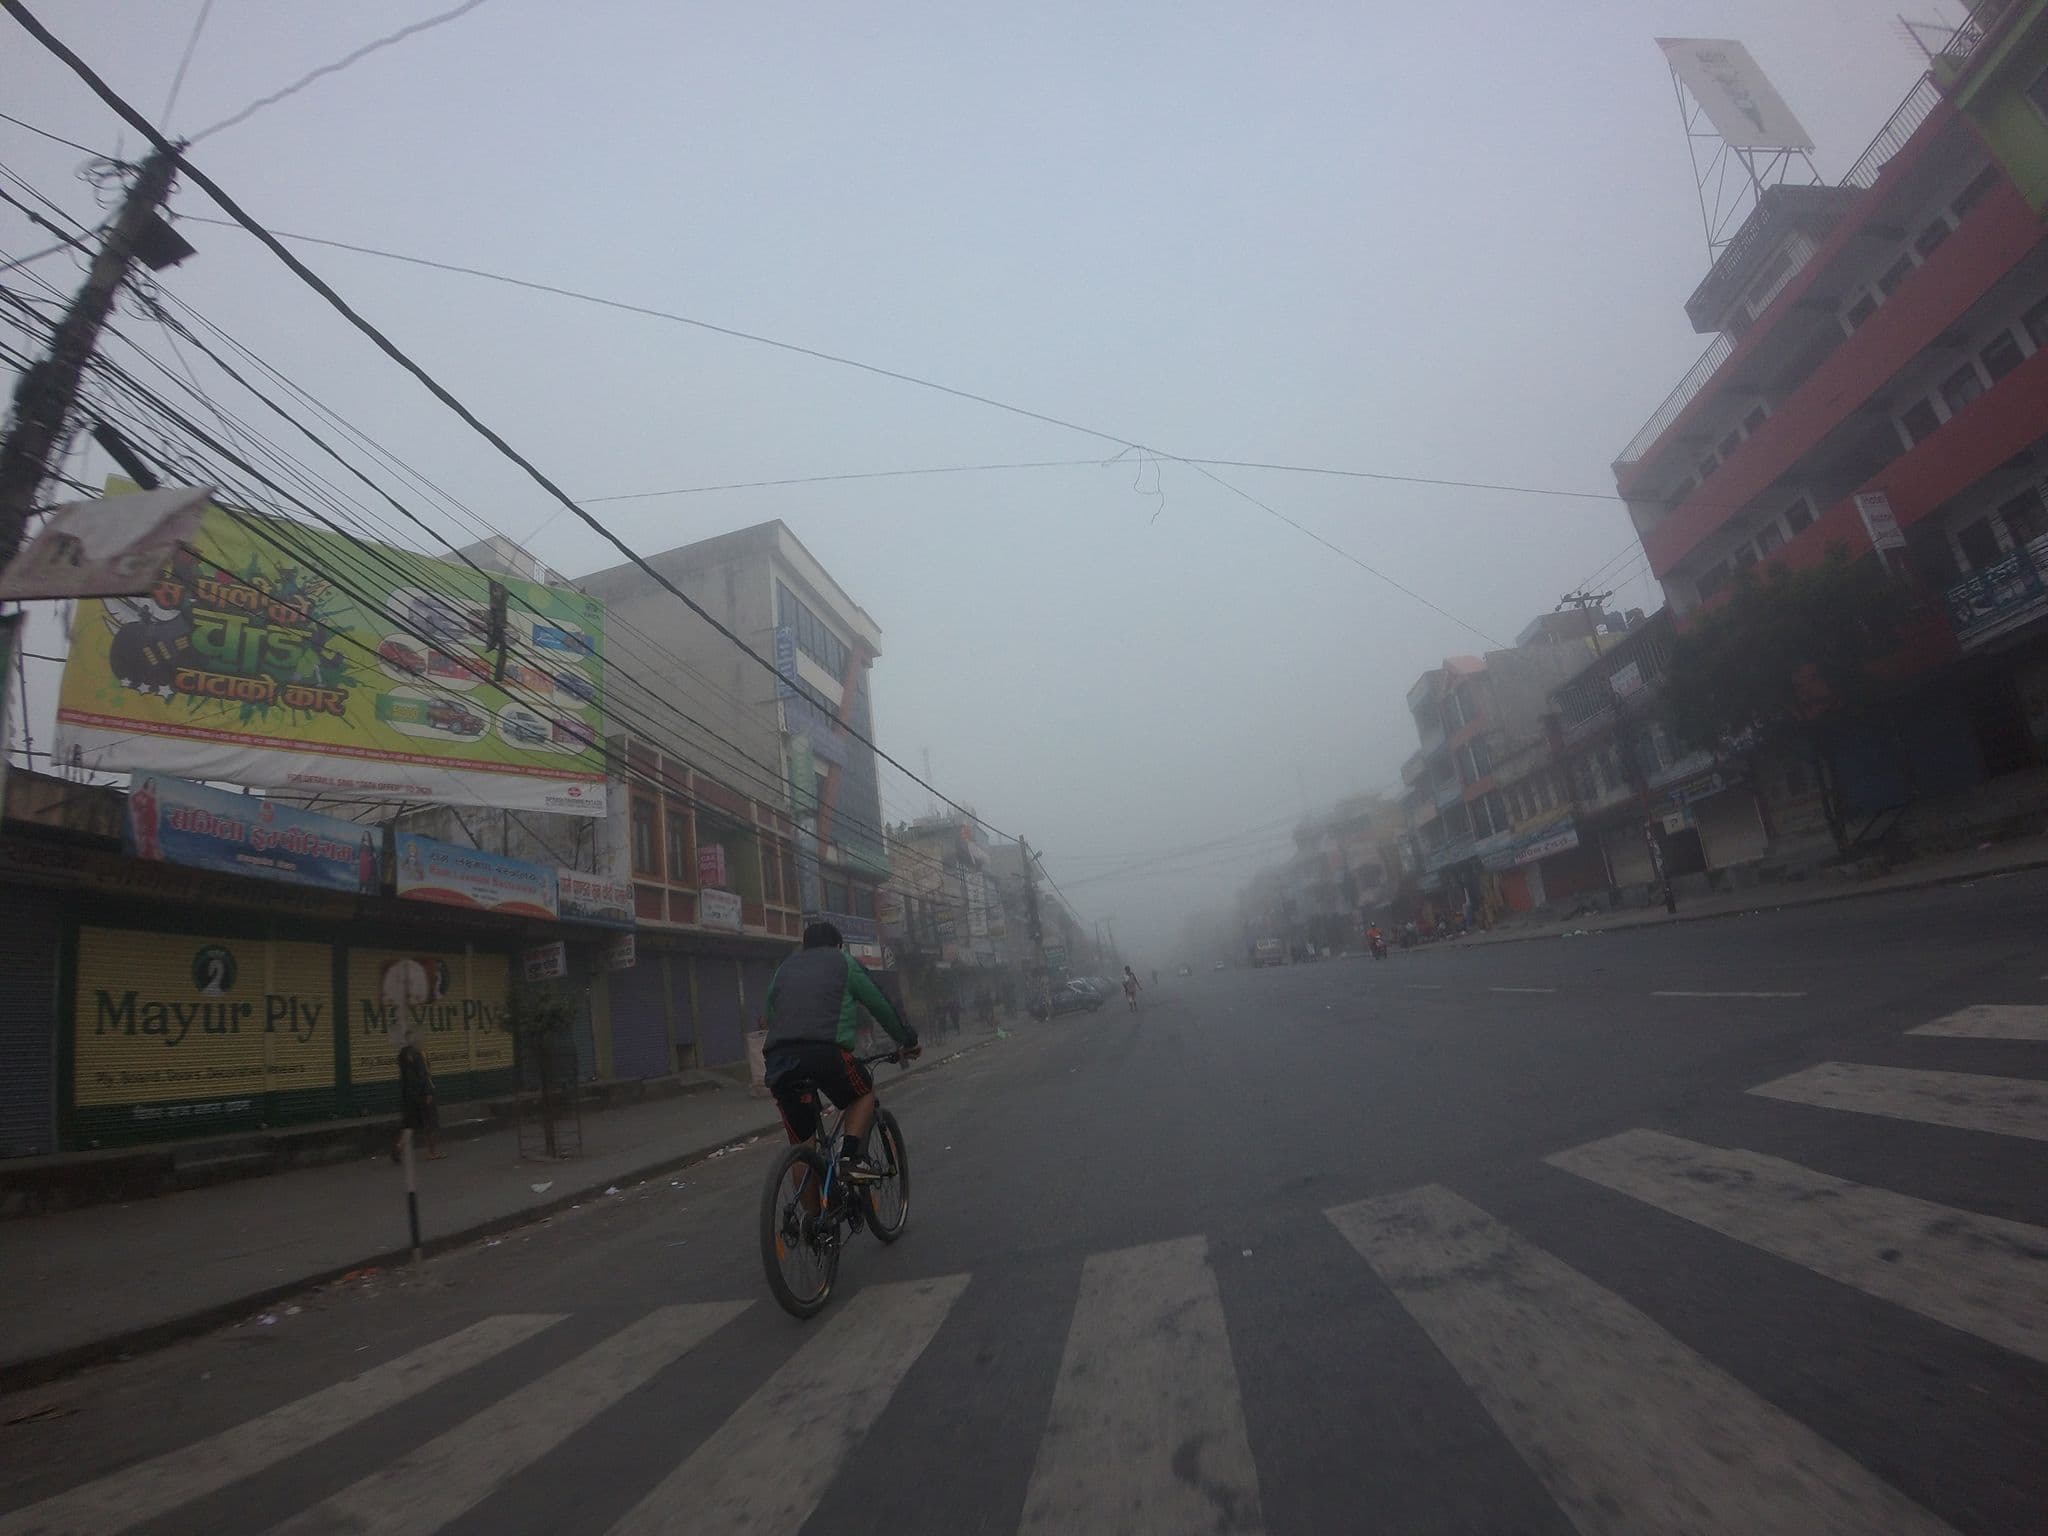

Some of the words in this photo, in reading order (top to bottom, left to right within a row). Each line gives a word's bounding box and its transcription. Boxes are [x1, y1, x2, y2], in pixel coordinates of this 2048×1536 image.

[175, 666, 278, 704] टाटाको
[283, 684, 348, 714] कार
[96, 988, 251, 1045] Mayur
[264, 993, 322, 1043] Ply
[463, 998, 497, 1035] Ply
